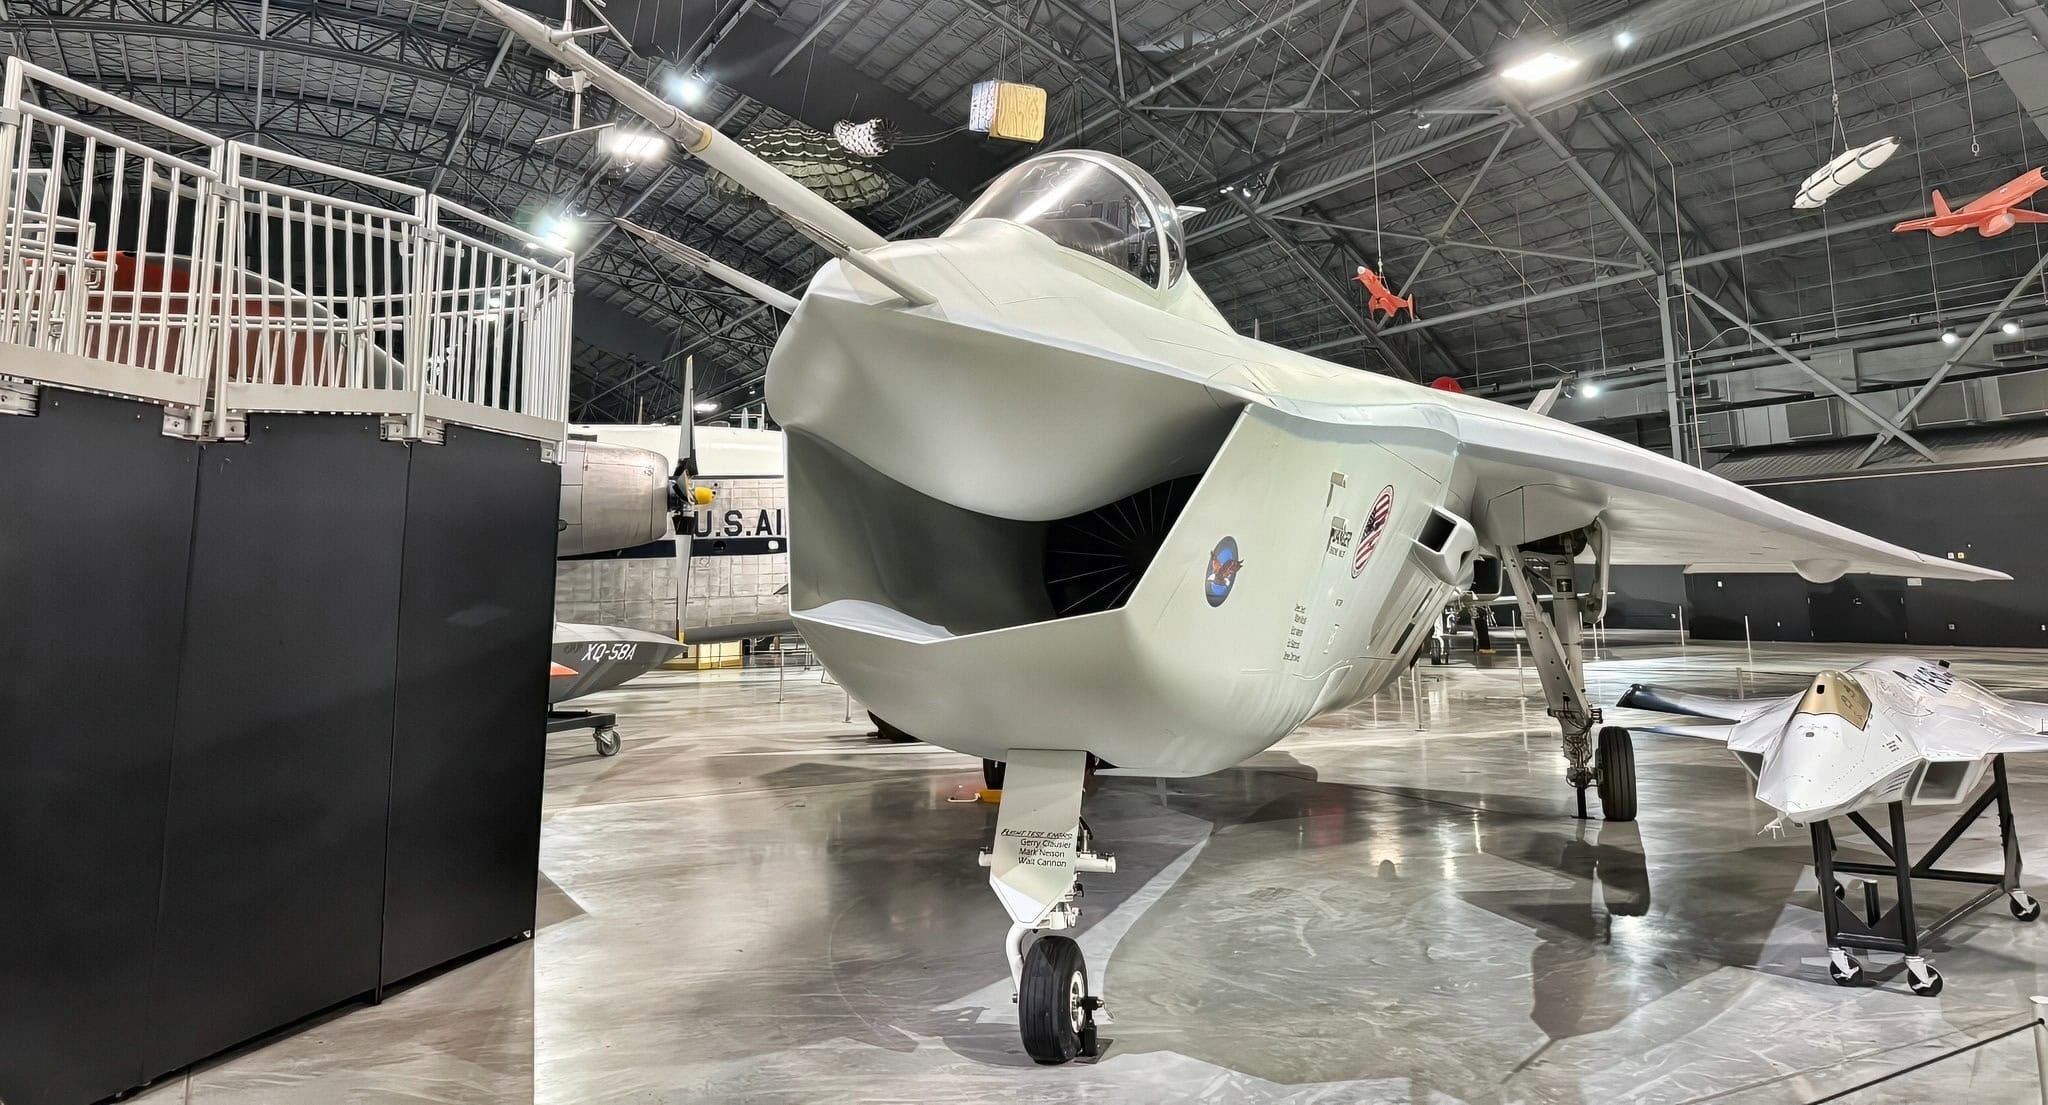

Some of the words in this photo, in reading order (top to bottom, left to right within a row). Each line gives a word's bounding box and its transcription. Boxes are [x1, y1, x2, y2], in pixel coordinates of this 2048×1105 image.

[581, 643, 638, 662] XQ-58A
[1020, 838, 1041, 848] Gerry
[1019, 848, 1037, 856] Mark
[1039, 849, 1065, 858] Nelson
[1018, 857, 1035, 865] Walt
[1037, 858, 1067, 867] Cannon
